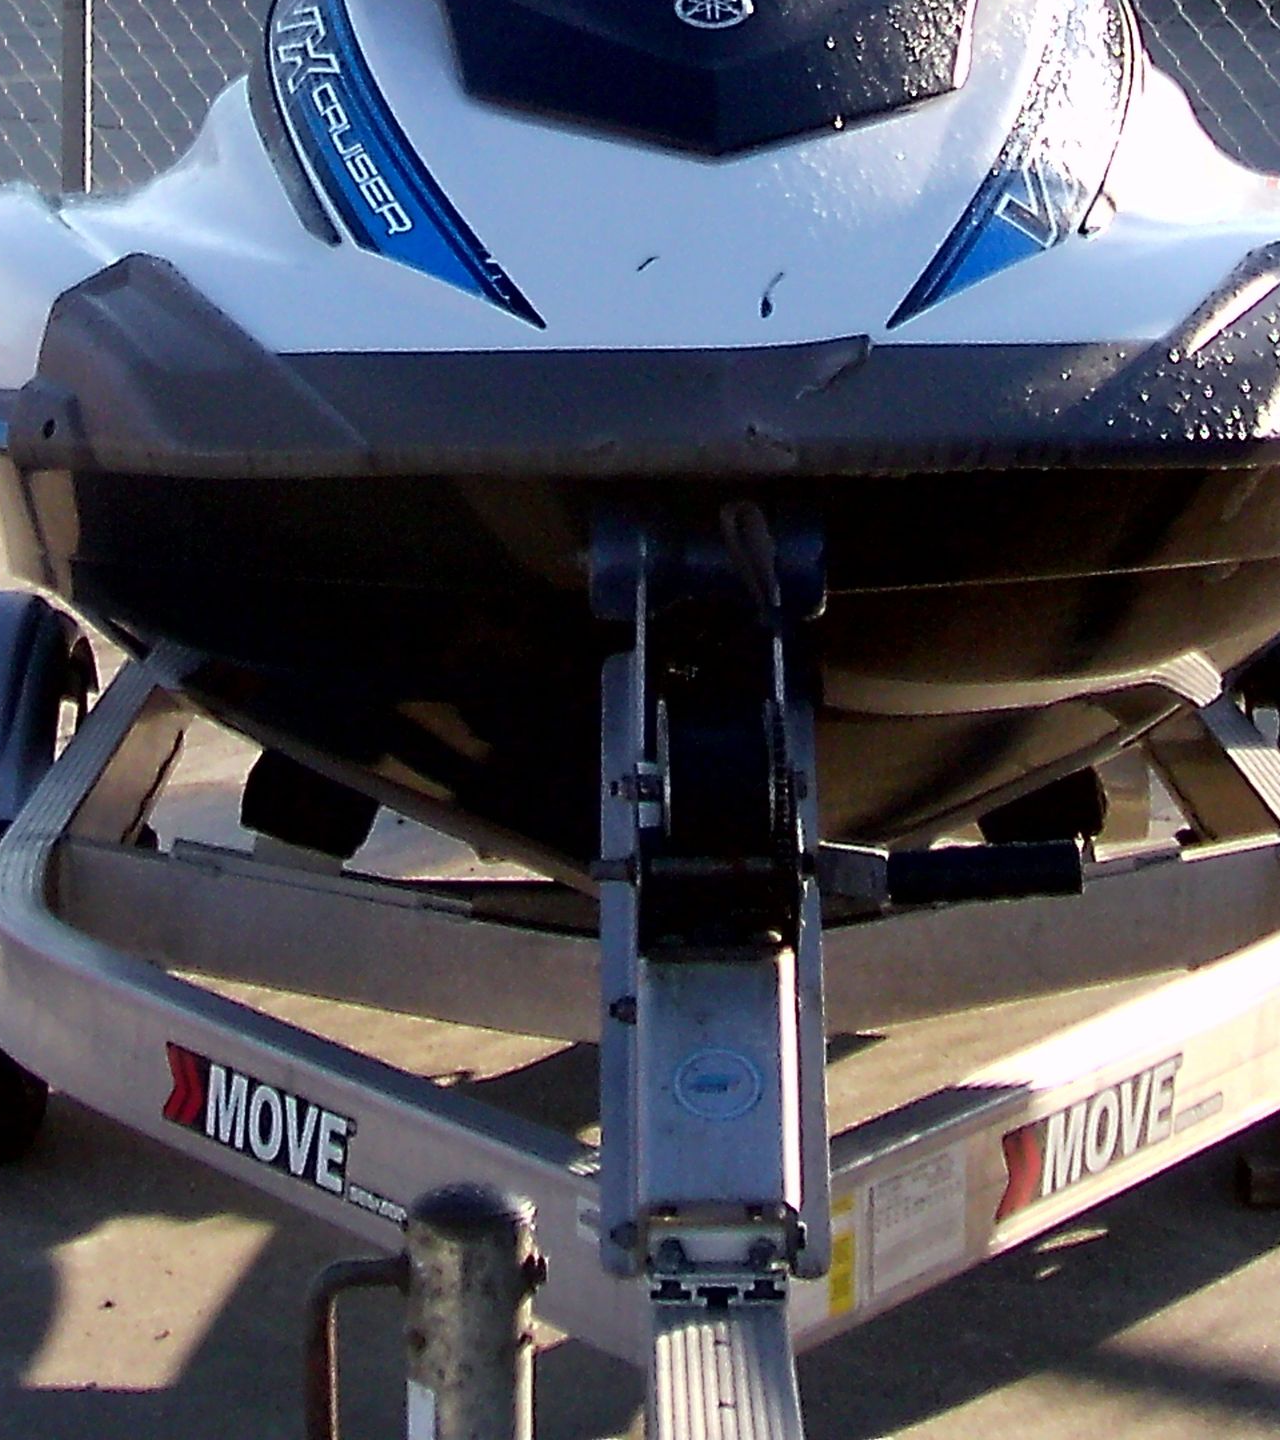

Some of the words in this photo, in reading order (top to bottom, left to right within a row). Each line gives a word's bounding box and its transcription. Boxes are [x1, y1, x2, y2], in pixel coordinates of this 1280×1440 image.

[312, 82, 412, 235] CRUISER
[206, 1063, 347, 1193] MOVE
[1041, 1060, 1177, 1198] MOVE
